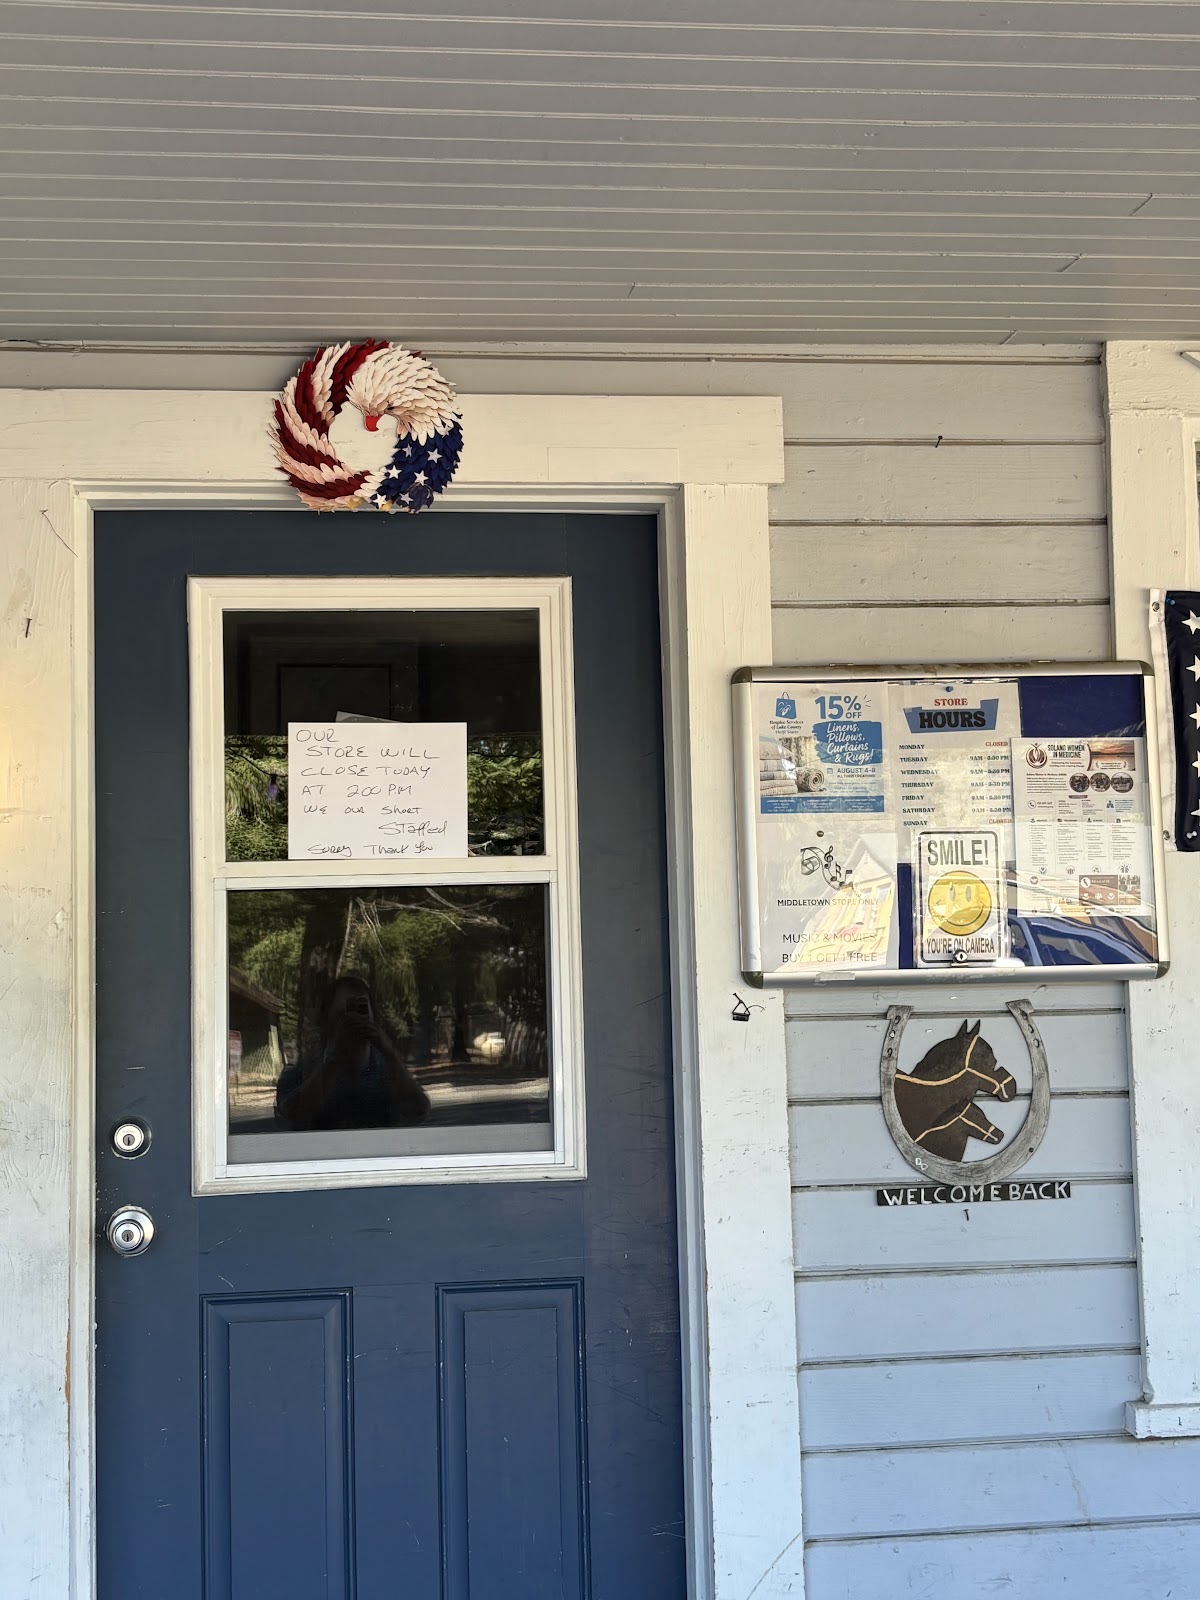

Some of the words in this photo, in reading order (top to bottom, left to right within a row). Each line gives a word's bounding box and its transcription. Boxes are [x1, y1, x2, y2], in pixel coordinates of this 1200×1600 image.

[815, 695, 861, 719] 15%
[934, 698, 968, 706] STORE
[919, 711, 986, 728] HOURS
[827, 723, 860, 733] Linens,
[296, 728, 339, 742] OUR
[826, 733, 865, 743] Pillows,
[306, 746, 369, 758] STORE
[381, 748, 440, 759] WILL
[827, 743, 868, 754] Curtains
[835, 755, 841, 763] &
[845, 749, 873, 765] Rugs!
[301, 765, 369, 777] CLOSE
[376, 766, 431, 778] TODAY
[302, 785, 326, 795] AT
[927, 840, 988, 866] SMILE!
[782, 933, 820, 943] MUSIC
[823, 934, 831, 942] &
[833, 932, 877, 943] MOVIES
[926, 938, 952, 953] YOU'RE
[965, 938, 995, 953] CAMERA
[782, 953, 805, 963] BUY
[816, 953, 839, 962] GET
[849, 953, 878, 962] FREE
[882, 1184, 1002, 1206] WELCOME
[1008, 1181, 1070, 1200] BACK
